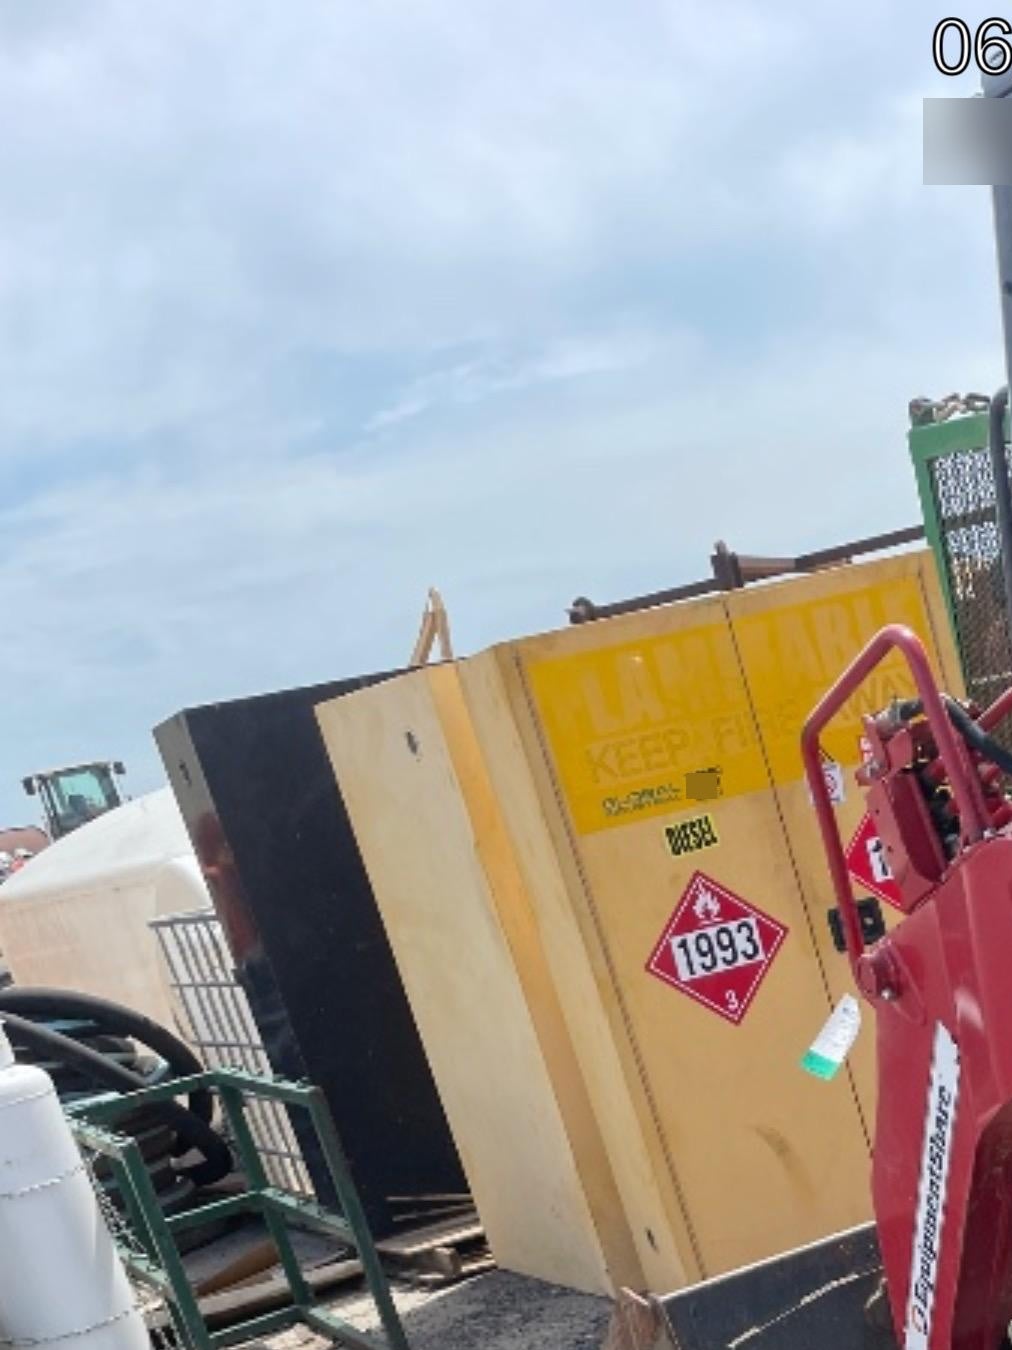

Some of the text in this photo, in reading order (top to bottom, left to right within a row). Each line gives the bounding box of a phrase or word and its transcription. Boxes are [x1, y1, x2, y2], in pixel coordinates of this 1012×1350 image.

[585, 726, 690, 784] KEEP
[665, 815, 718, 856] DIESEL
[677, 920, 760, 976] 1993
[725, 989, 739, 1010] 3
